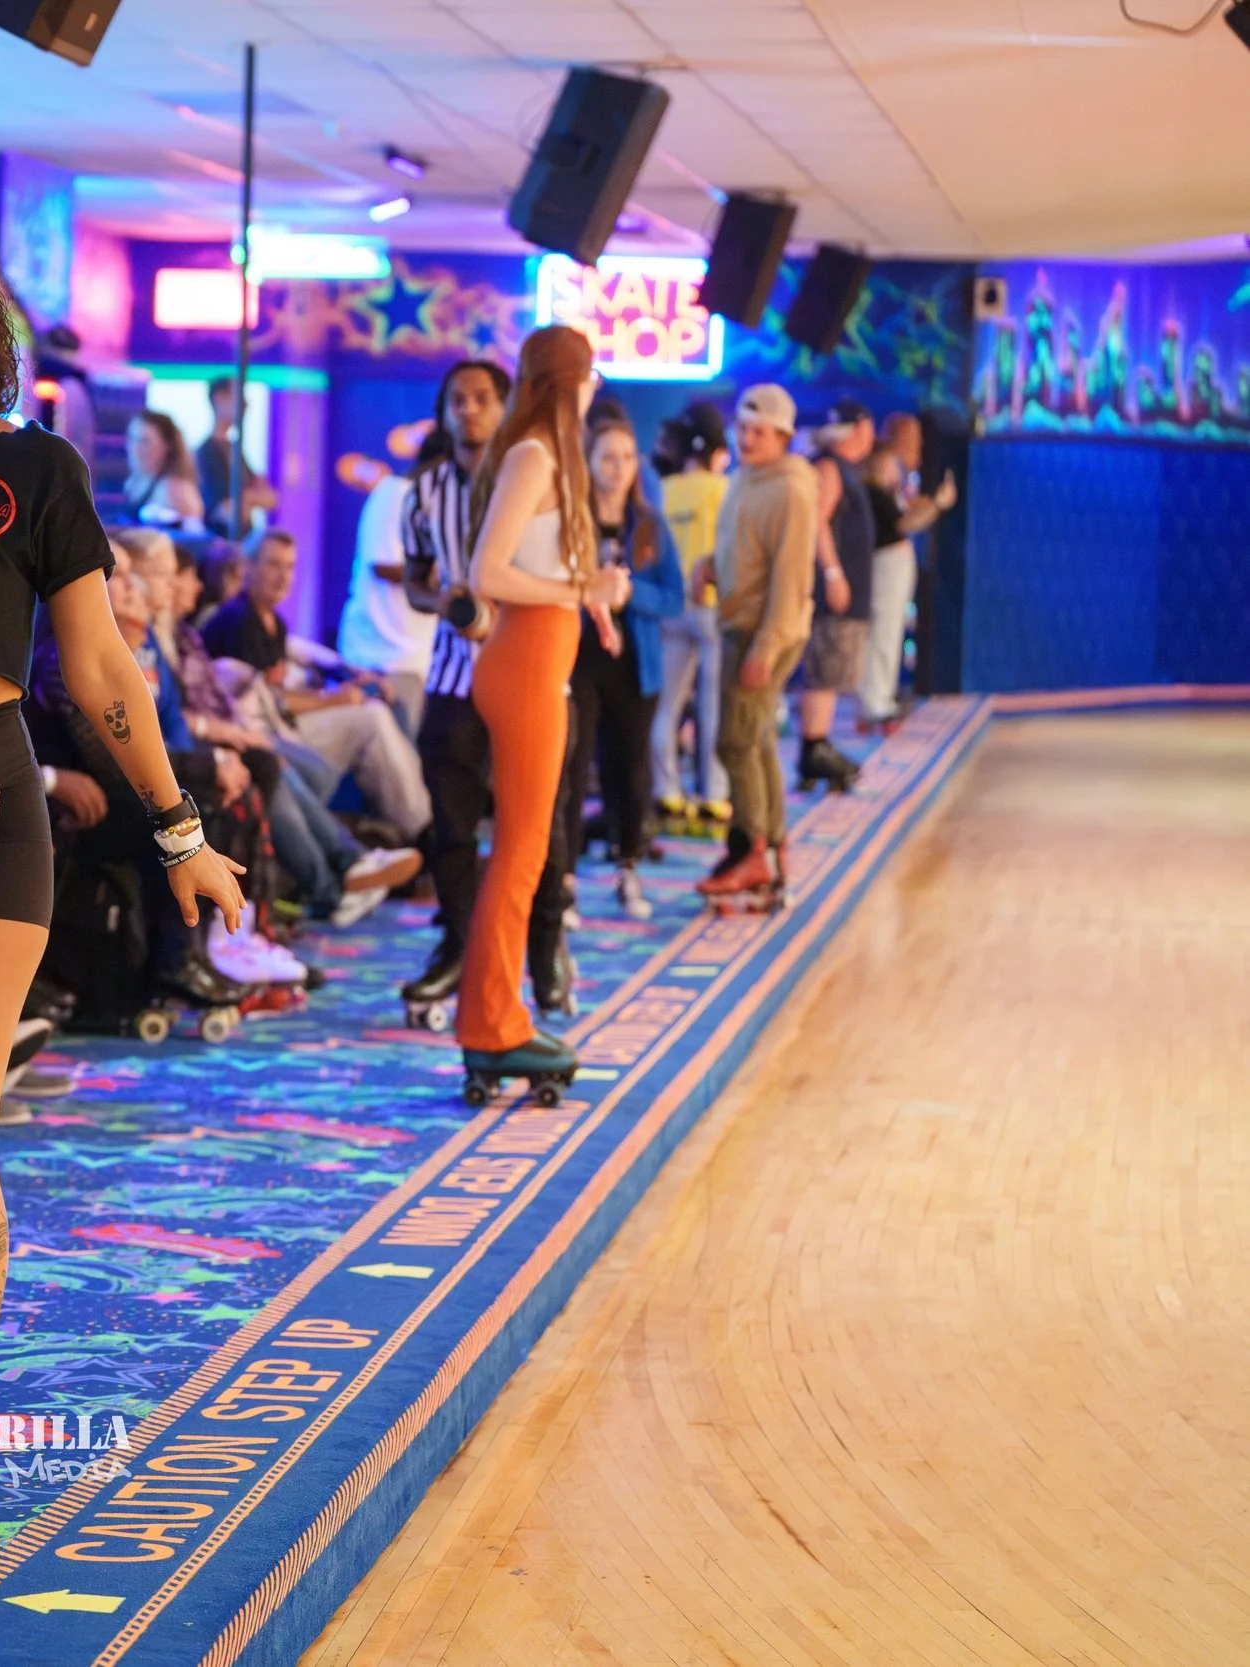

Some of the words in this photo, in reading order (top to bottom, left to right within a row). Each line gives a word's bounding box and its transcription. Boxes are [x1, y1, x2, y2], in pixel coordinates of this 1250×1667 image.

[552, 265, 709, 324] SKATE
[271, 1318, 379, 1349] UP
[201, 1359, 343, 1422] STEP
[54, 1434, 279, 1562] CAUTION
